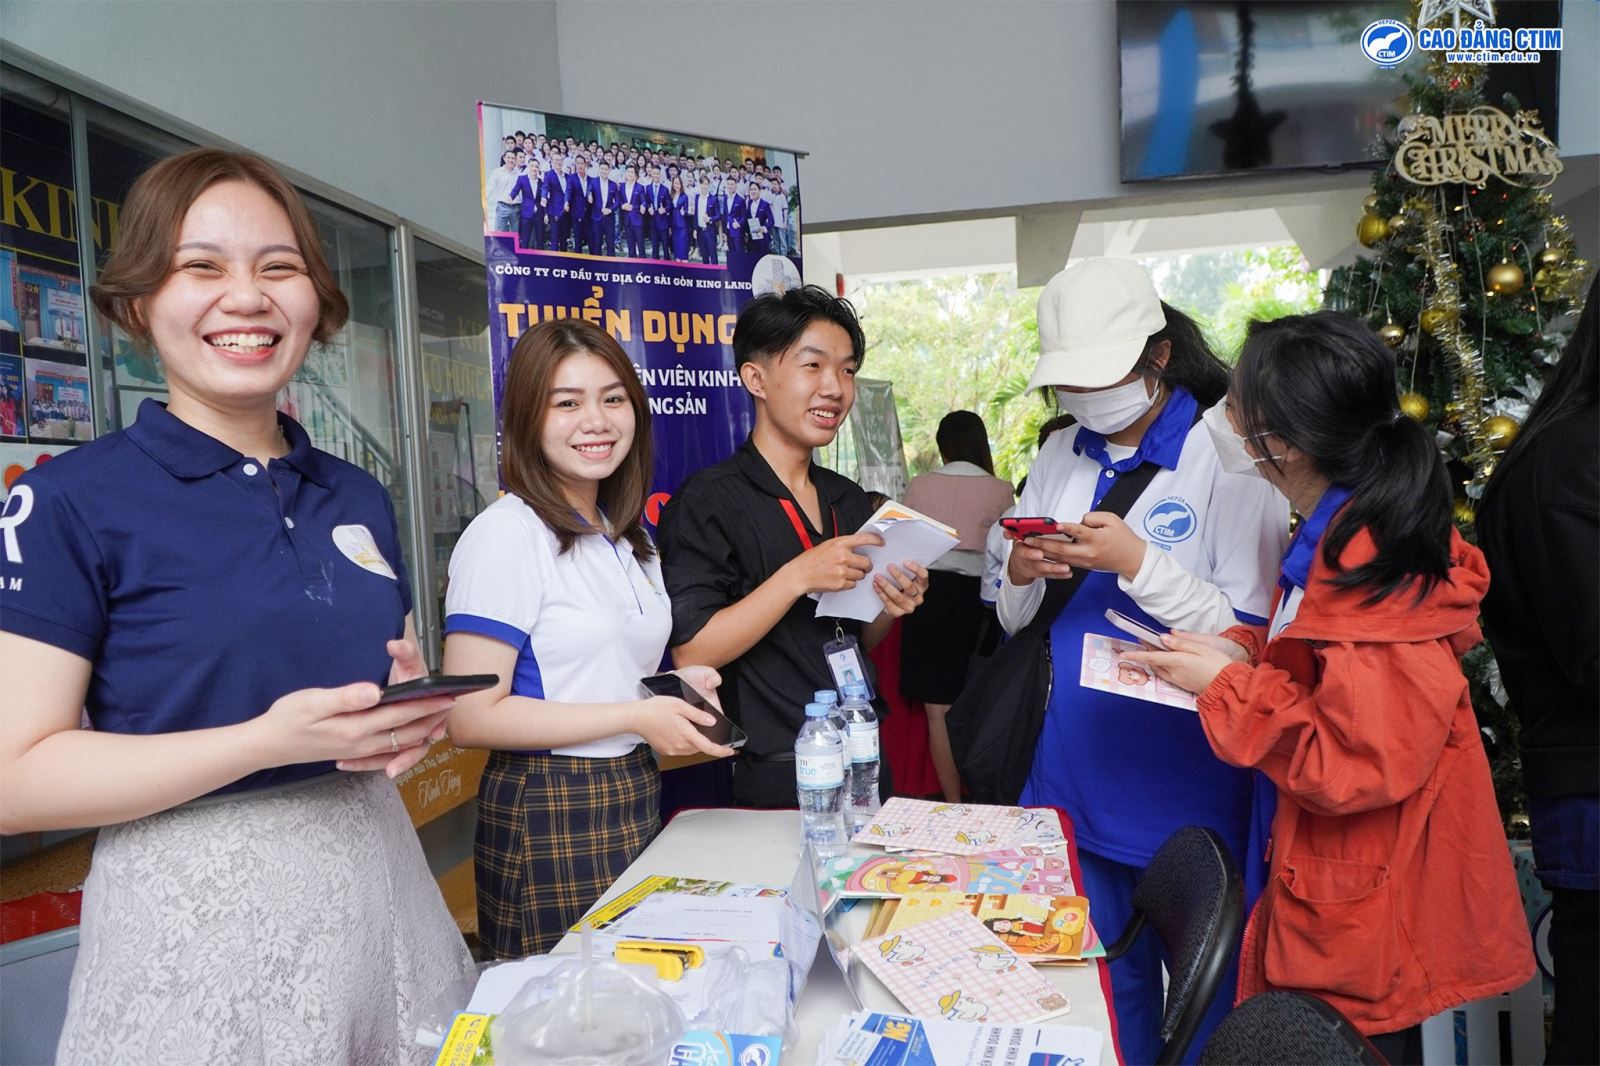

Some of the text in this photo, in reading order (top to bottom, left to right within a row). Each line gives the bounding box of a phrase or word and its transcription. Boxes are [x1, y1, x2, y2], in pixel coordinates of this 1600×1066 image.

[1418, 107, 1523, 147] MERRY
[1395, 142, 1564, 188] CHRISTMAS
[495, 263, 531, 276] CÔNG
[534, 267, 549, 277] TY
[552, 269, 568, 278] CP
[595, 273, 609, 281] TƯ
[612, 274, 632, 285] ĐỊA
[636, 272, 651, 284] ỐC
[654, 274, 671, 285] SÀI
[673, 276, 693, 287] GÒN
[696, 280, 721, 289] KING
[724, 281, 752, 290] LAND
[658, 363, 696, 387] VIÊN
[698, 370, 742, 387] KINH
[675, 391, 707, 415] SẢN
[1155, 526, 1176, 537] CTIM
